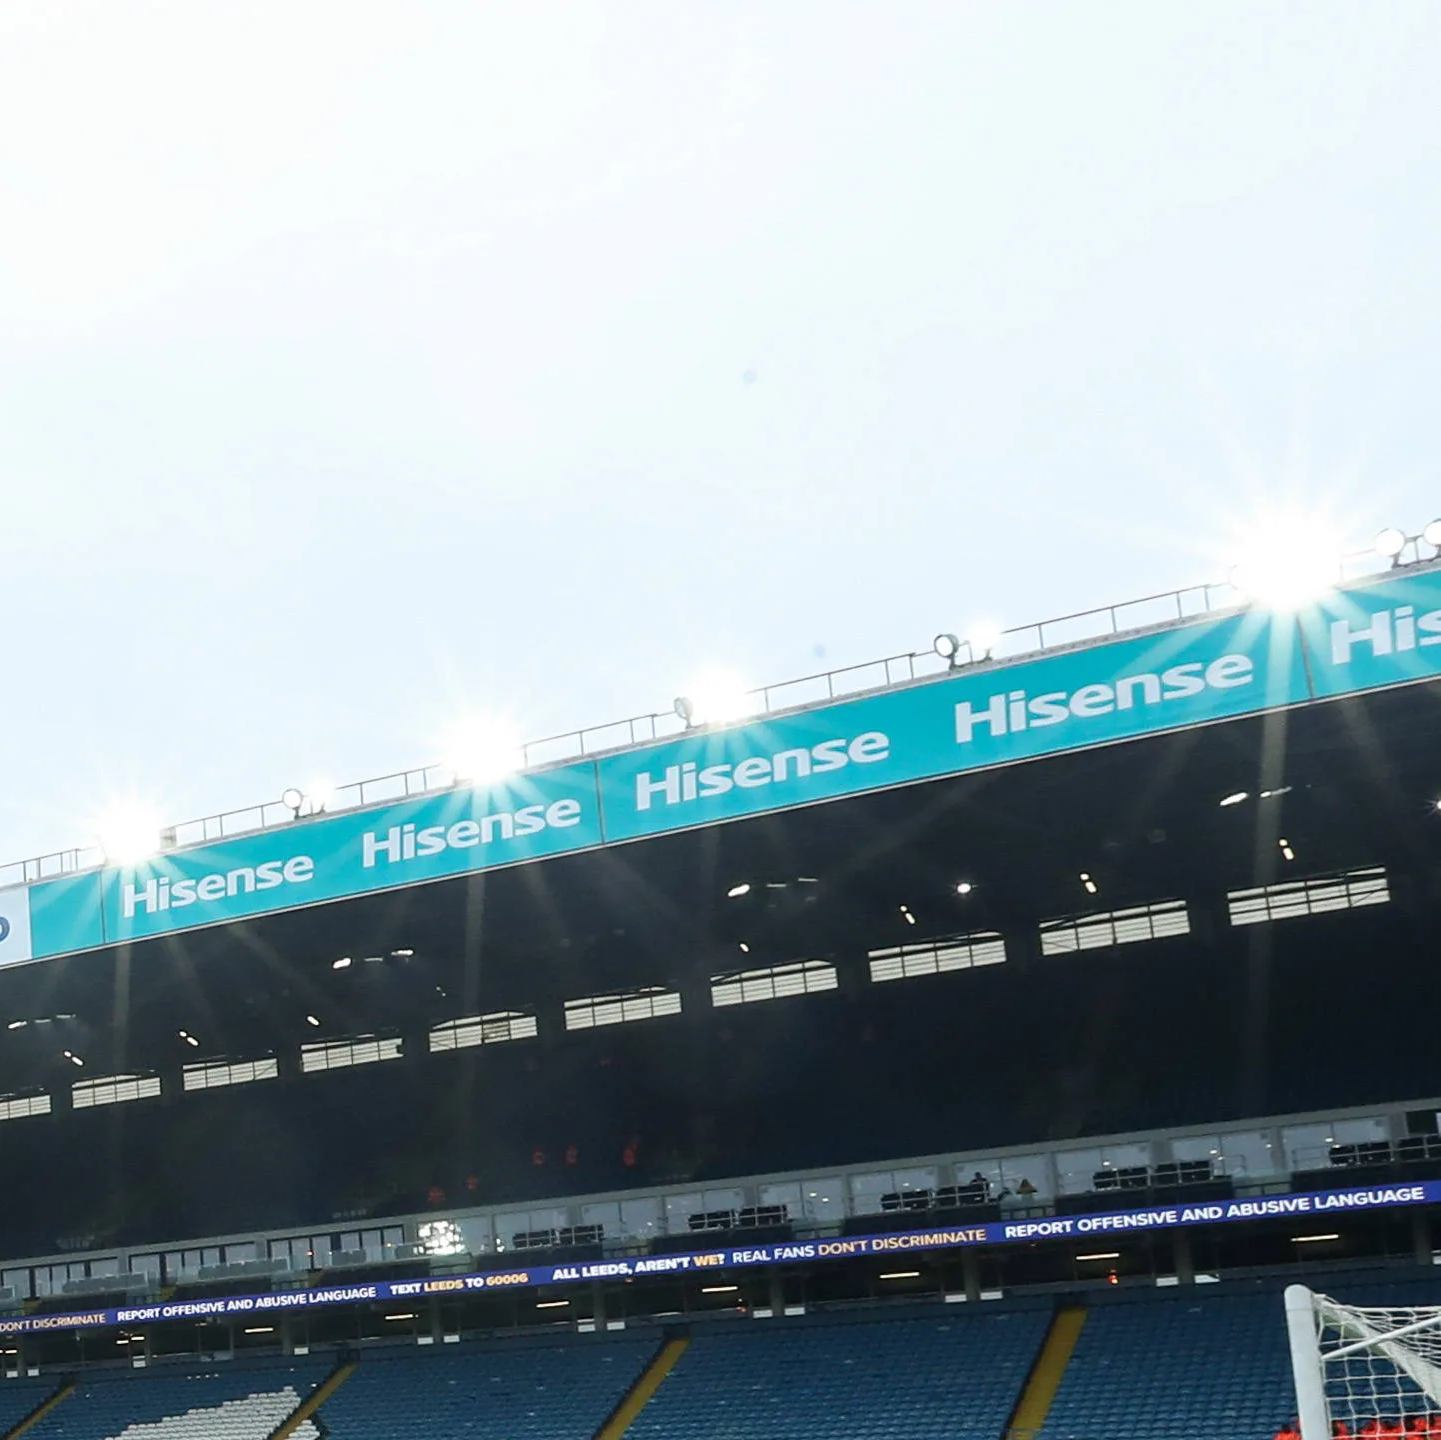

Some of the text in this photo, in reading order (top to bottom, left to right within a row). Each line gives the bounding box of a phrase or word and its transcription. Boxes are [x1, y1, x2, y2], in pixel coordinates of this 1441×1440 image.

[954, 653, 1253, 745] Hisense
[635, 730, 889, 812] Hisense
[362, 799, 581, 868] Hisense
[123, 855, 314, 919] Hisense
[1006, 1187, 1424, 1238] REPORT OFFENSIVE AND ABUSIVE LANGUAGE
[553, 1229, 986, 1280] ALL LEEDS, AREN'T WE? REAL FANS DON'T DISCRIMINATE
[118, 1287, 376, 1321] REPORT OFFENSIVE AND ABUSIVE LANGUAGE
[390, 1273, 528, 1294] TEXT LEEDS TO 60006
[0, 1321, 30, 1332] DON'T
[33, 1314, 105, 1328] DISCRIMINATE
